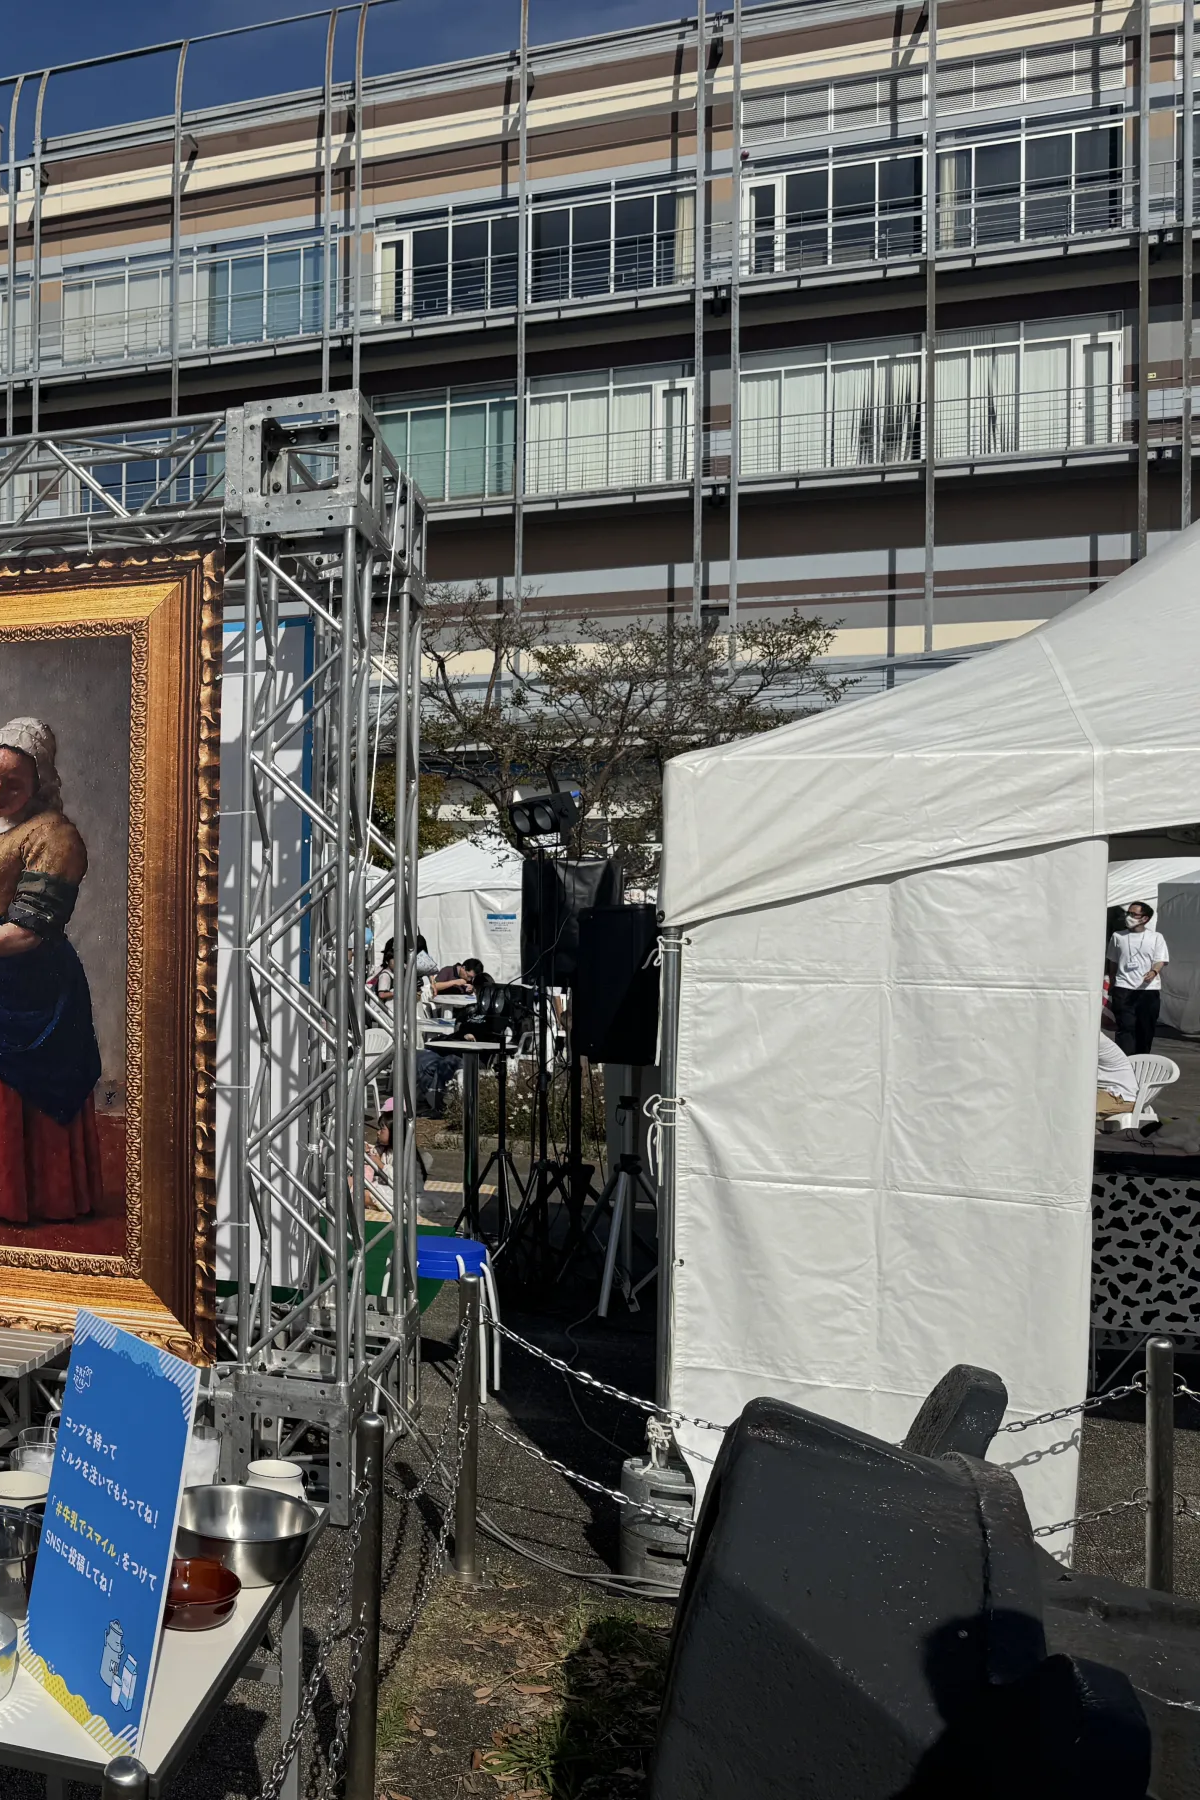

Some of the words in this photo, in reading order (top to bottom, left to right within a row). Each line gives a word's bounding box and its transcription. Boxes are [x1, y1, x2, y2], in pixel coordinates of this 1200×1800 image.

[65, 1416, 118, 1461] コップを持って
